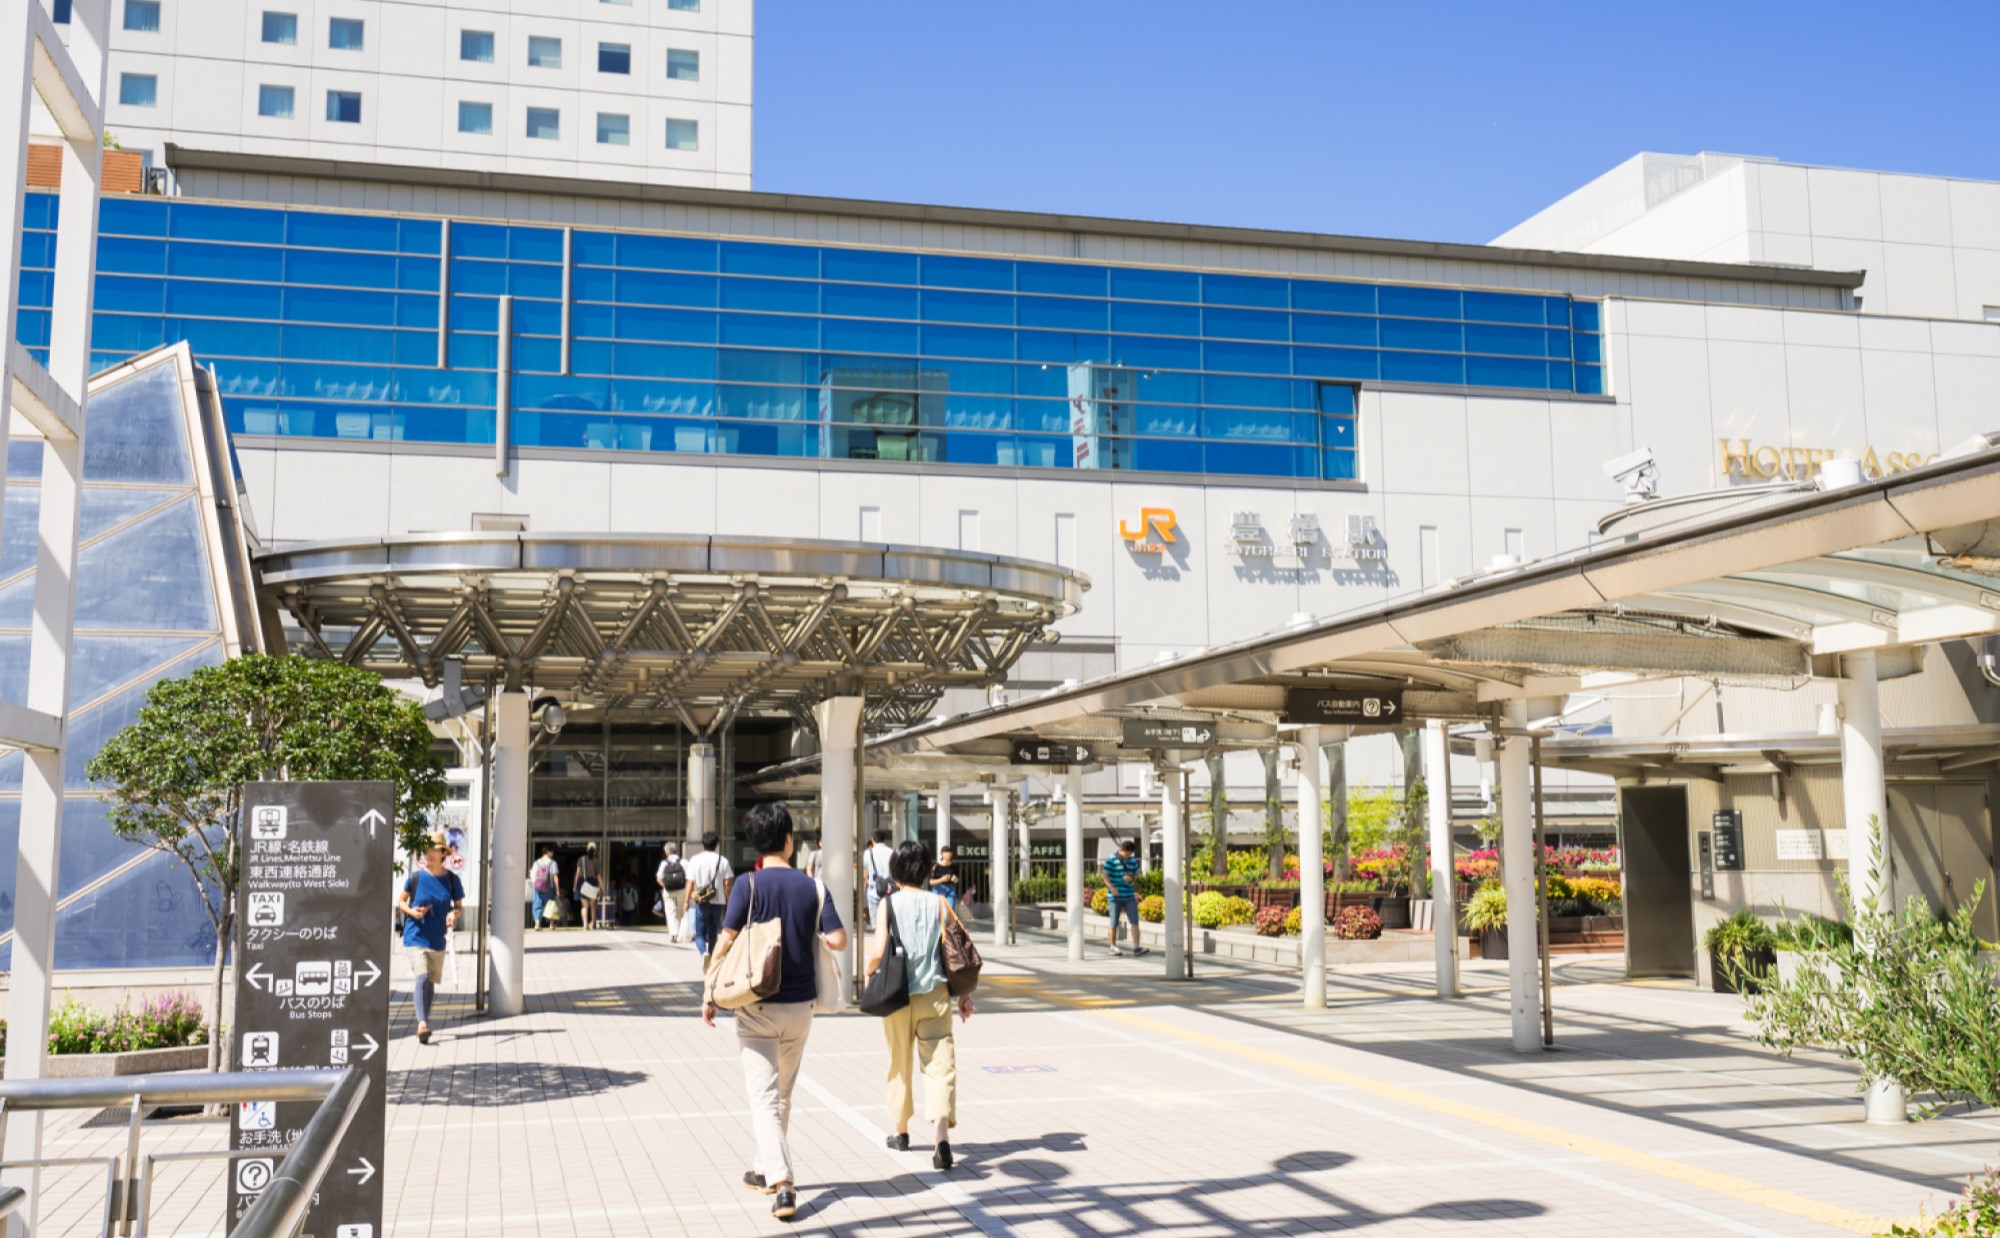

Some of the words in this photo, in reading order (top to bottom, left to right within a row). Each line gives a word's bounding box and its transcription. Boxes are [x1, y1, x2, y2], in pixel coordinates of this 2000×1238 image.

[1119, 507, 1177, 543] JR
[957, 845, 1021, 857] EXCER
[1028, 843, 1063, 856] AFFÉ
[323, 853, 342, 862] Line
[249, 864, 337, 879] 東西連絡通路
[304, 879, 326, 888] West
[328, 879, 350, 888] Side)
[251, 894, 281, 903] TAXI
[247, 926, 338, 941] タクシーのりば
[246, 941, 265, 950] Taxi
[280, 995, 346, 1010] バスのりば
[289, 1011, 306, 1019] Bus
[307, 1010, 332, 1020] Stops
